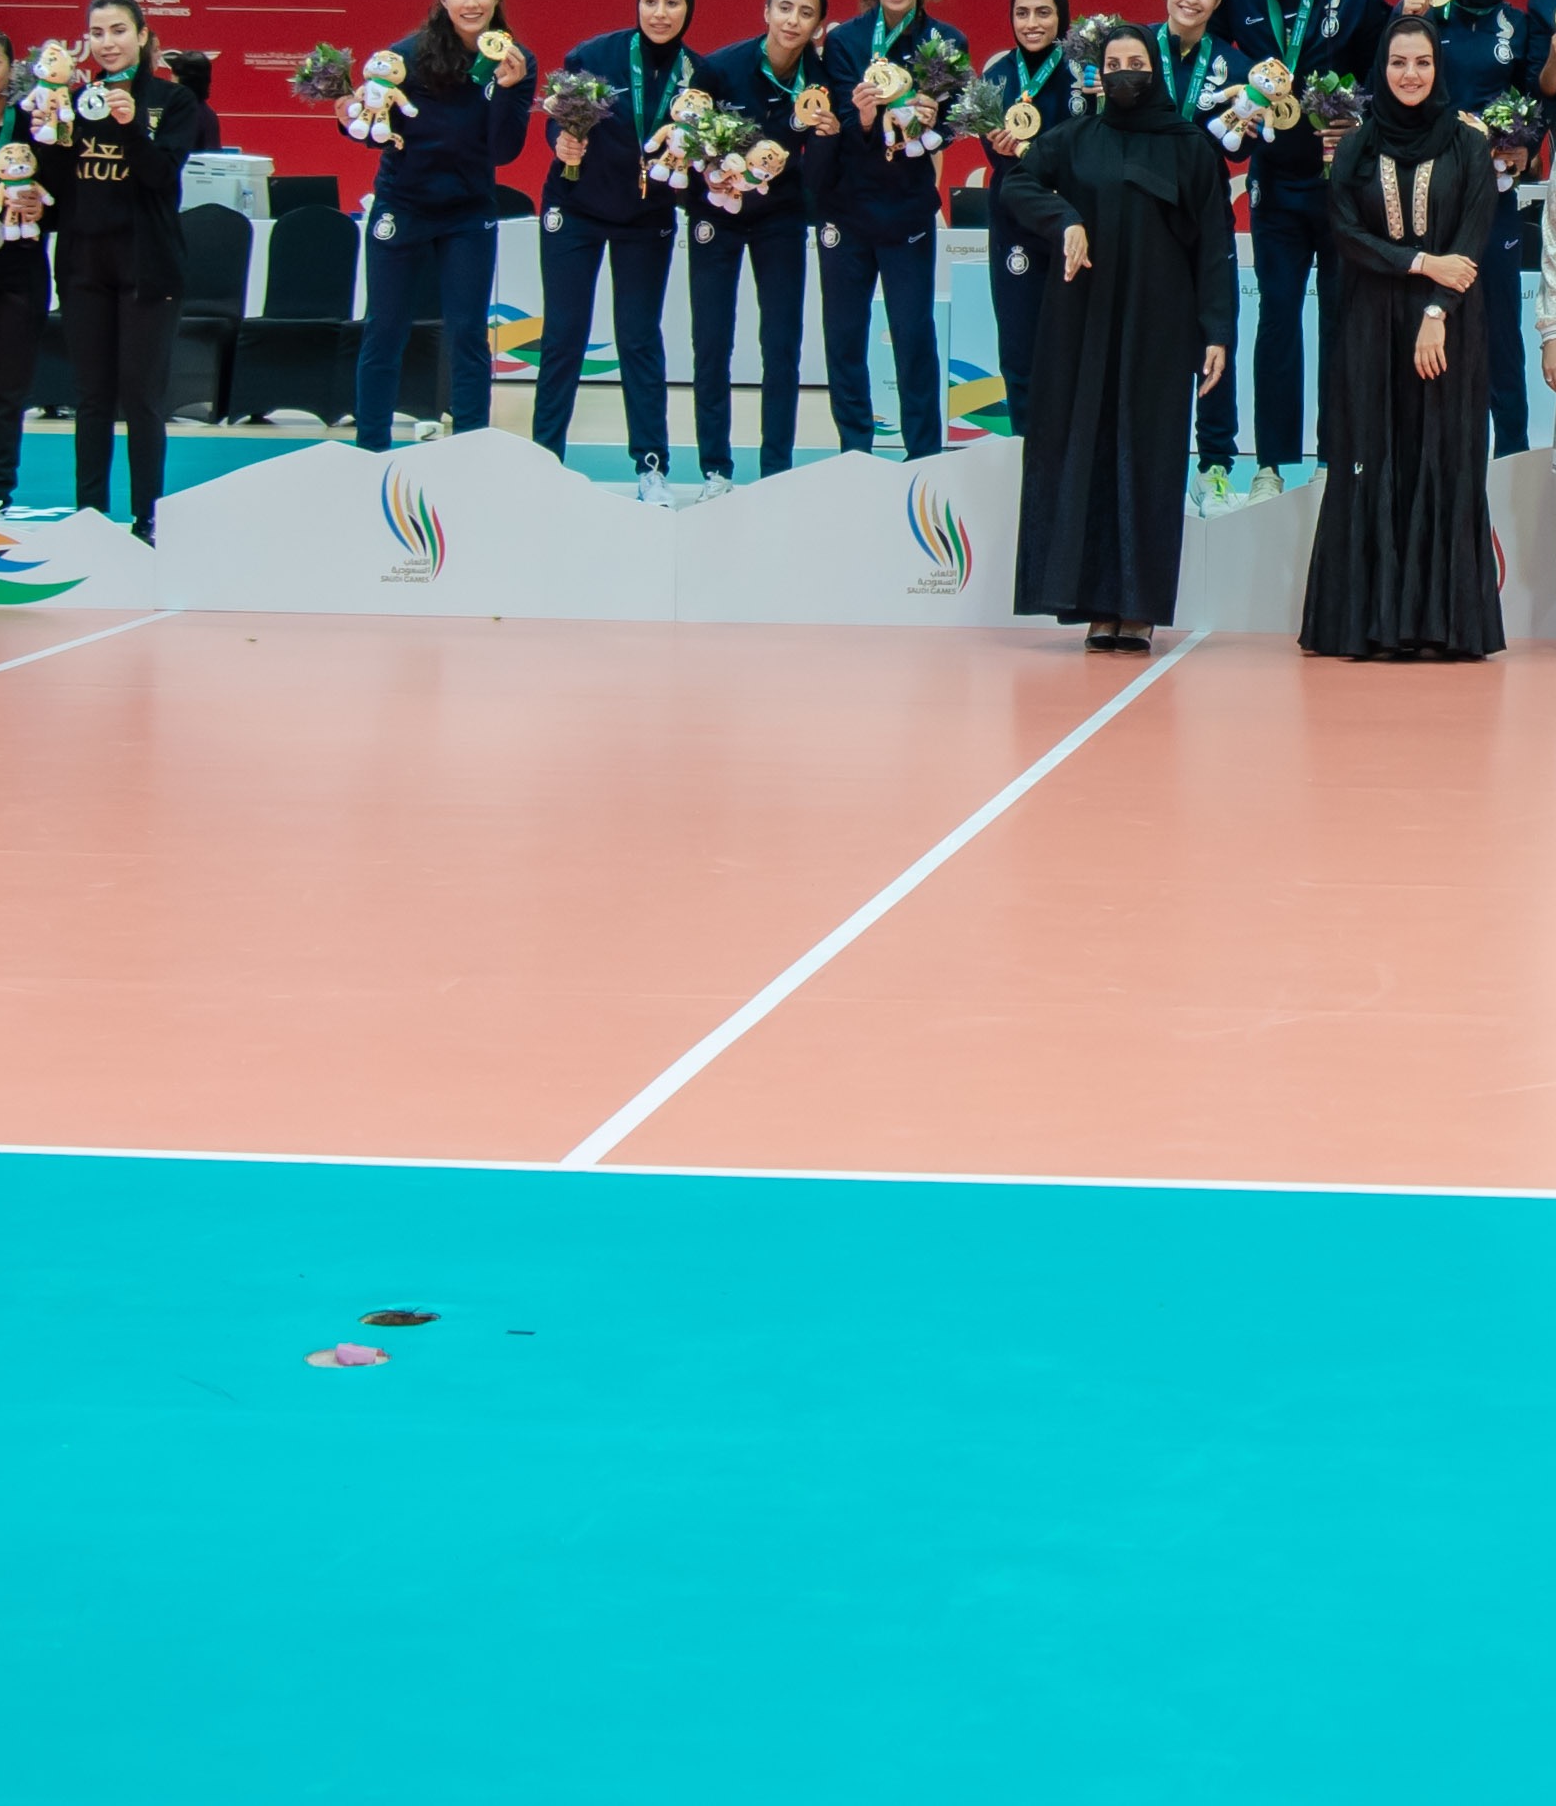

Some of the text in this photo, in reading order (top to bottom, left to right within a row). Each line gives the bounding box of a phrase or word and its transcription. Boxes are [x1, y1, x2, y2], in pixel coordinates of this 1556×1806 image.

[148, 7, 192, 17] PARTNERS
[404, 575, 430, 583] GAMES
[930, 586, 957, 595] GAMES
